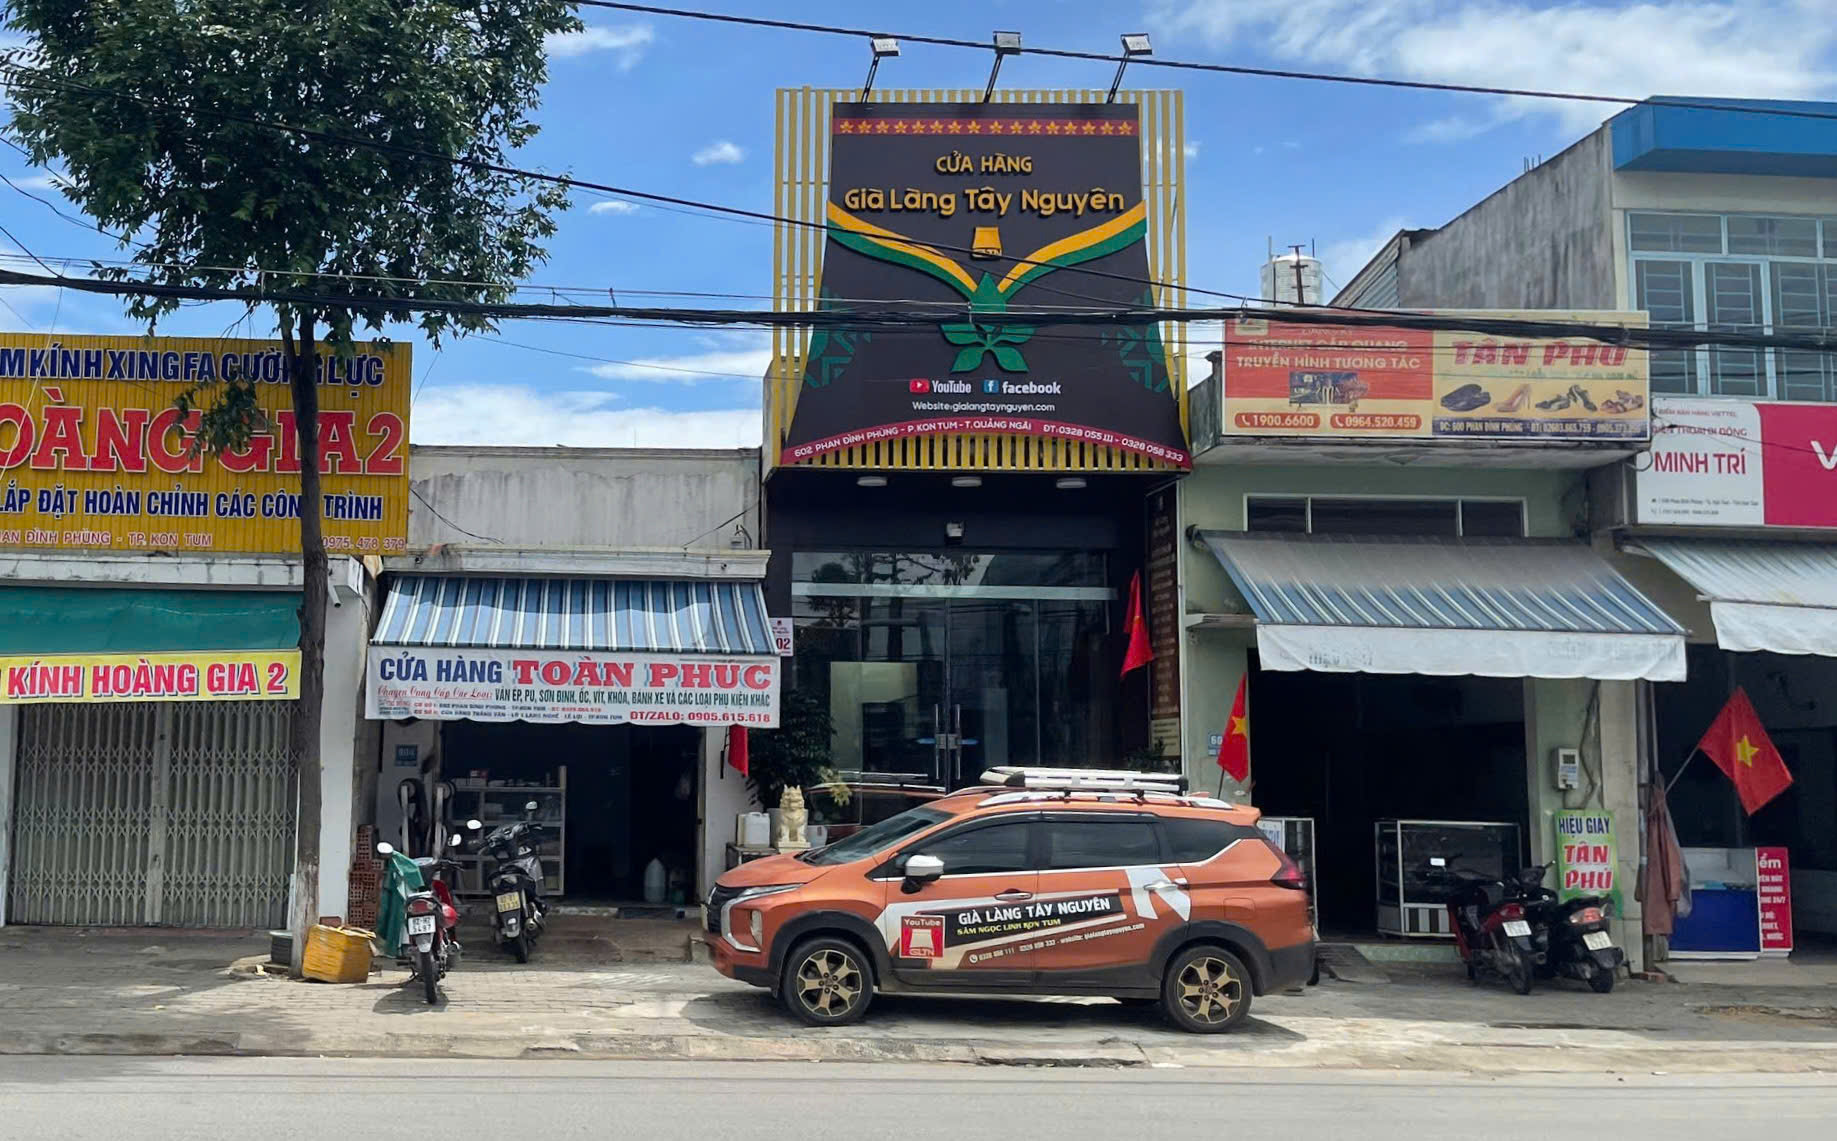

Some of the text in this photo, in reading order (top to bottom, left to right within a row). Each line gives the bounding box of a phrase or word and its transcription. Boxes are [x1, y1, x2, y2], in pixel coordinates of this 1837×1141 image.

[936, 150, 1032, 173] CỬA HÀNG
[844, 186, 1124, 216] Già Làng Tây Nguyên
[29, 342, 103, 379] KÍNH
[1295, 354, 1329, 368] HÌNH
[1391, 354, 1421, 369] TÁC
[932, 380, 972, 393] YouTube
[1002, 381, 1061, 394] facebook
[1253, 415, 1314, 426] 1900.6600
[366, 412, 404, 475] 2
[795, 447, 813, 457] 602
[815, 439, 841, 452] PHAN
[842, 434, 865, 445] ĐÌNH
[866, 427, 898, 441] PHÙNG
[937, 421, 957, 430] TUM
[1121, 438, 1145, 450] 0328
[1165, 450, 1183, 462] 333
[1654, 447, 1746, 474] MINH TRÍ
[37, 484, 78, 520] ĐẶT
[84, 485, 141, 516] HOÀN
[147, 484, 209, 517] CHỈNH
[215, 488, 256, 519] CÁC
[323, 491, 383, 520] TRÌNH
[26, 528, 58, 544] ĐÌNH
[63, 529, 111, 545] PHÙNG
[151, 533, 179, 546] KON
[184, 533, 213, 546] TUM
[357, 537, 379, 549] 478
[383, 538, 405, 550] 379
[7, 659, 288, 698] KÍNH HOÀNG GIA 2
[380, 651, 428, 681] CỬA
[436, 655, 502, 683] HÀNG
[509, 656, 635, 687] TOÀN
[654, 691, 664, 704] XE
[678, 689, 693, 705] CÁC
[1559, 814, 1583, 838] HIỆU
[1564, 841, 1609, 863] TÂN
[1565, 867, 1612, 889] PHÚ
[905, 918, 941, 926] YouTube
[958, 896, 1111, 925] GIÀ LÀNG TÂY NGUYÊN
[978, 925, 1001, 935] NGỌC
[1004, 923, 1022, 931] LINH
[1042, 918, 1061, 927] TUM
